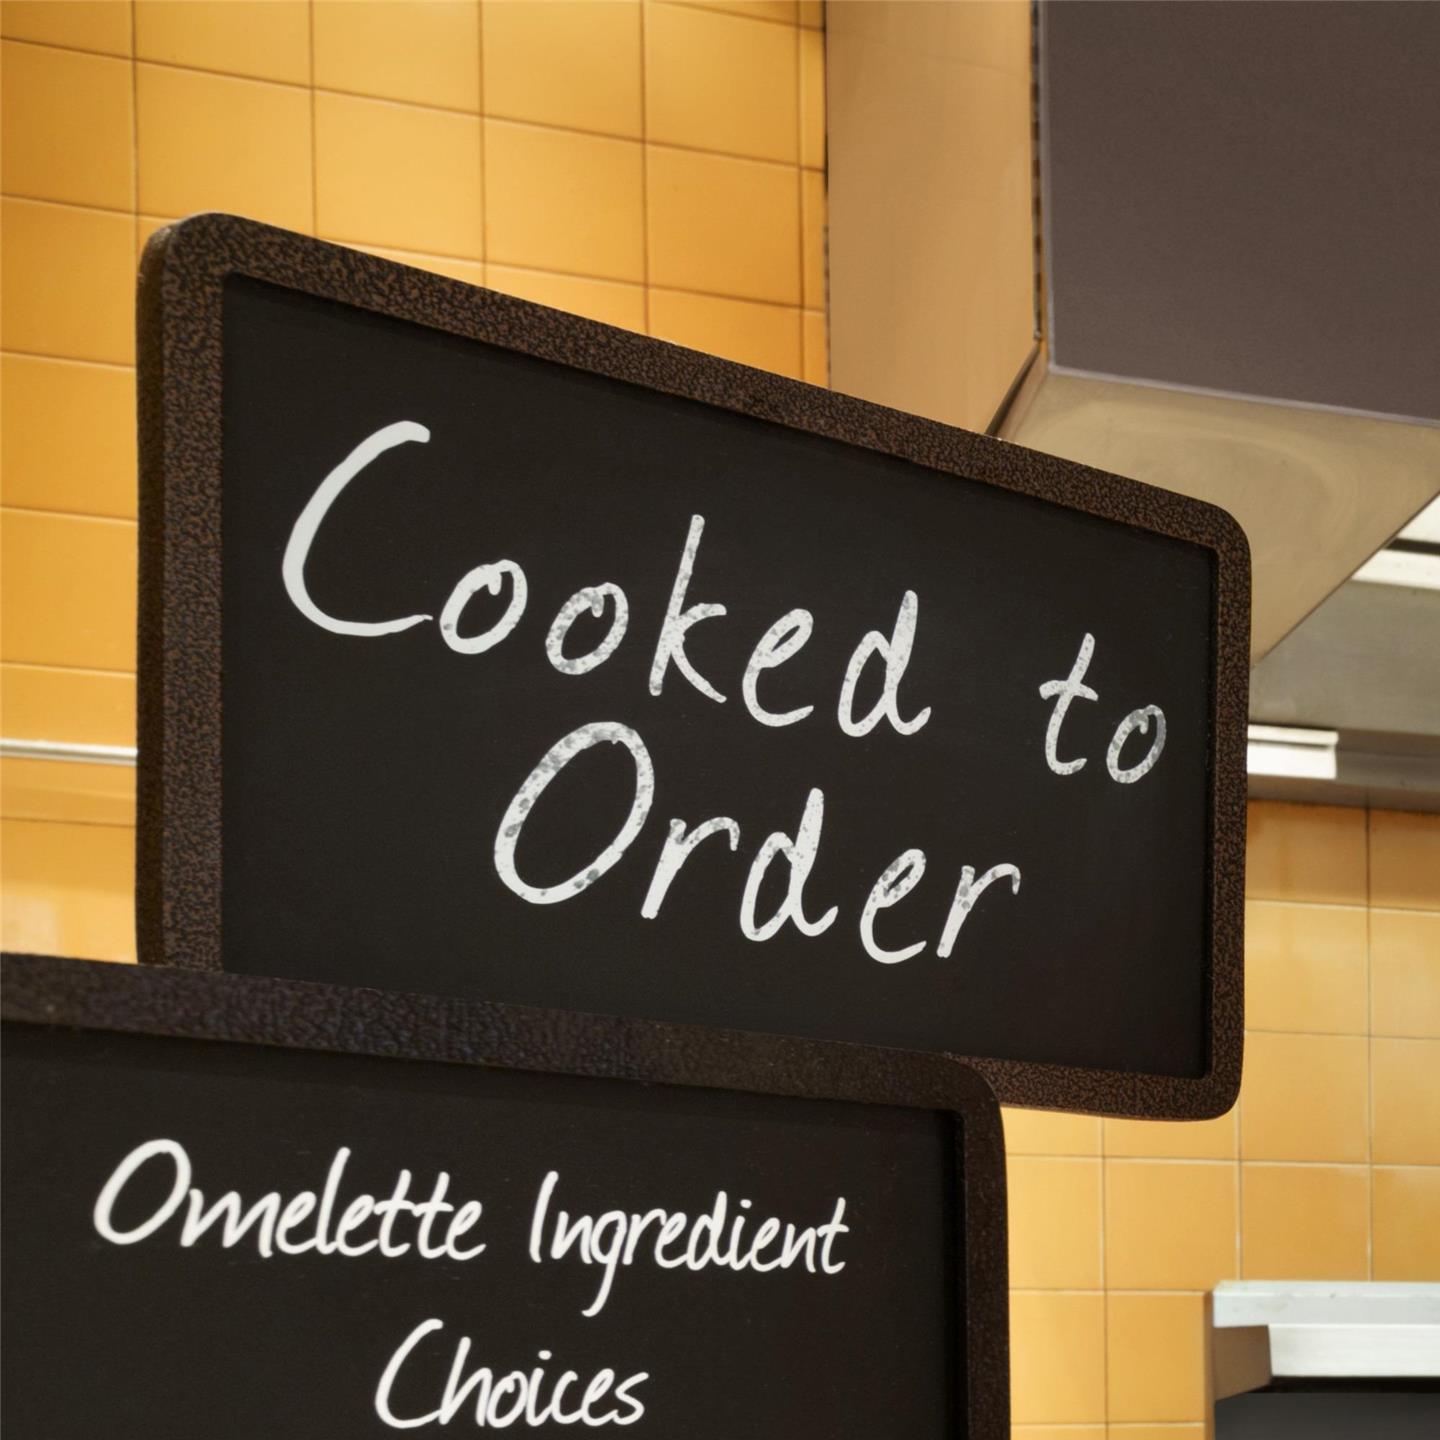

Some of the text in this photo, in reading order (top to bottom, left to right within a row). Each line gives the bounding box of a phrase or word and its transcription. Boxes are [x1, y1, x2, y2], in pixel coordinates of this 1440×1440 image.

[281, 420, 1168, 784] Cooked to
[493, 720, 1022, 965] Order
[92, 1138, 850, 1318] Omelette Ingredient
[374, 1317, 650, 1430] Choices
